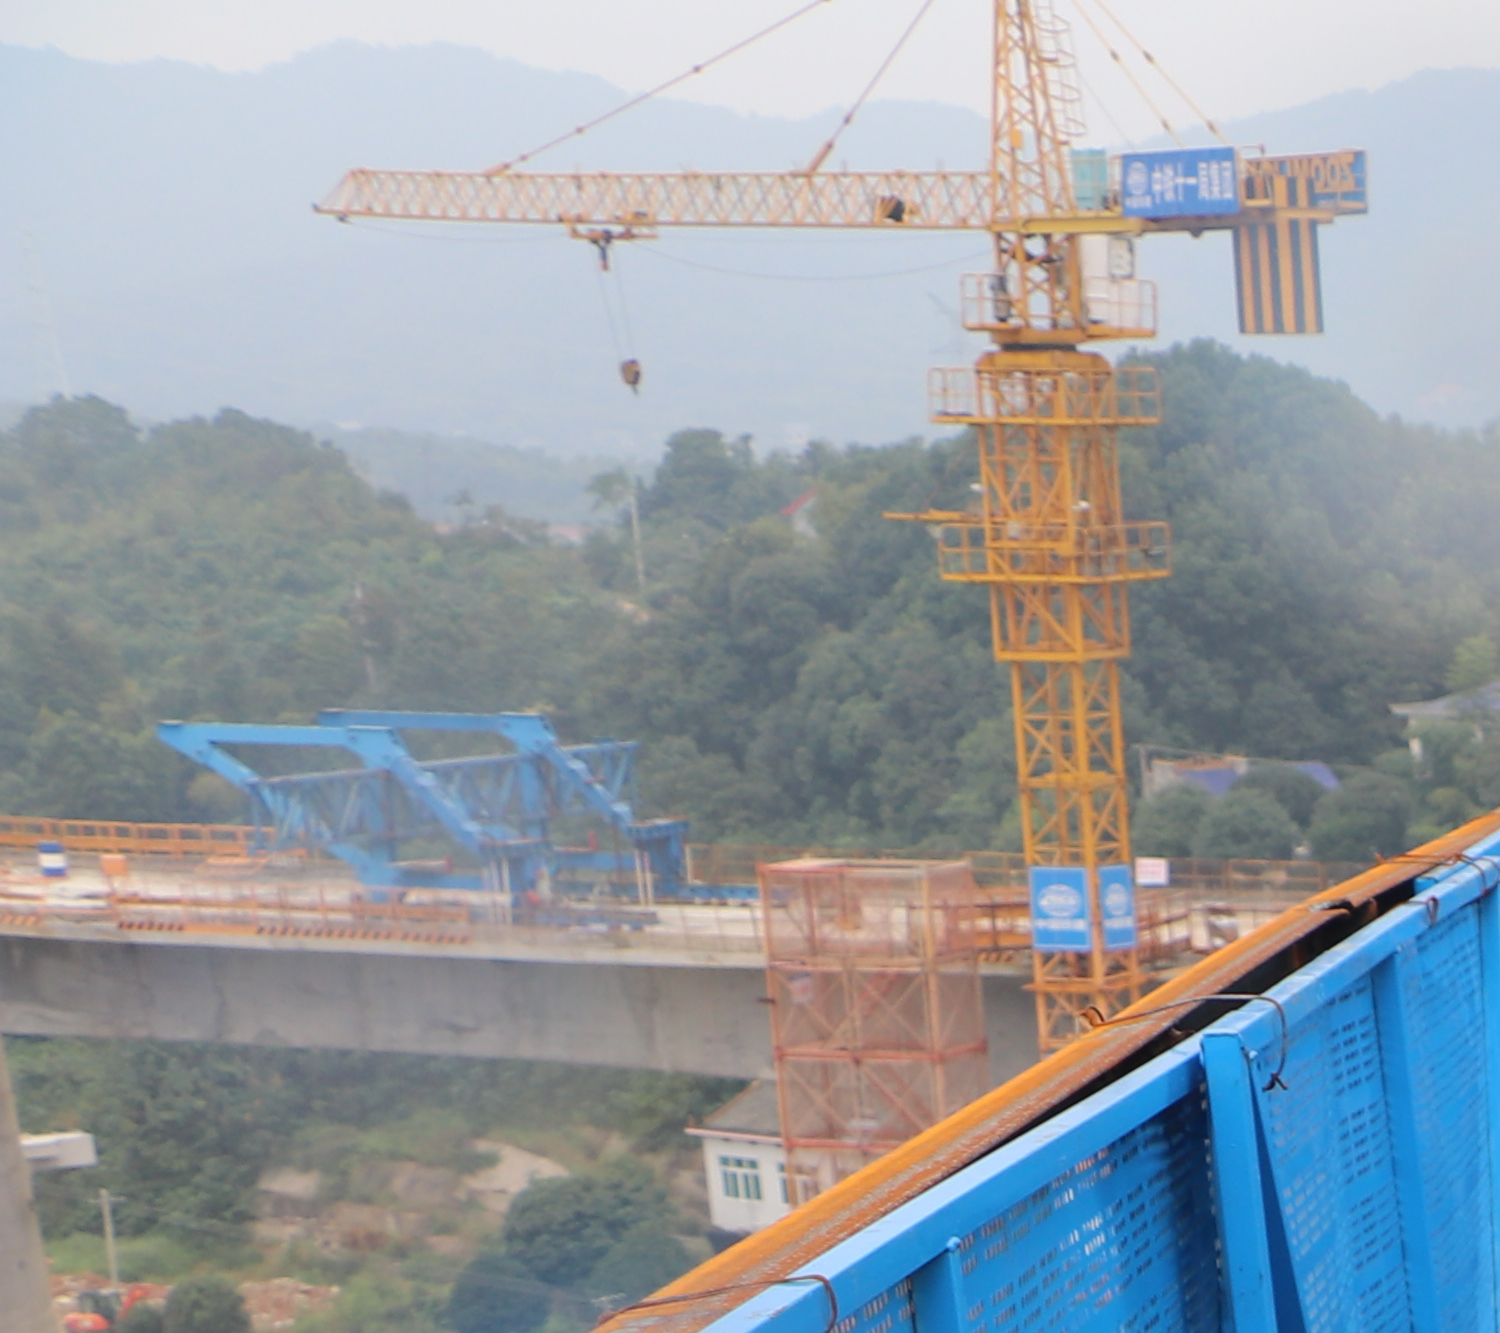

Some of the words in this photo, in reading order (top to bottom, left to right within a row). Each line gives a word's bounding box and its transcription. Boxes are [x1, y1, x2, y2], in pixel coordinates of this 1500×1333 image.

[1151, 160, 1234, 204] 中铁十一局集团
